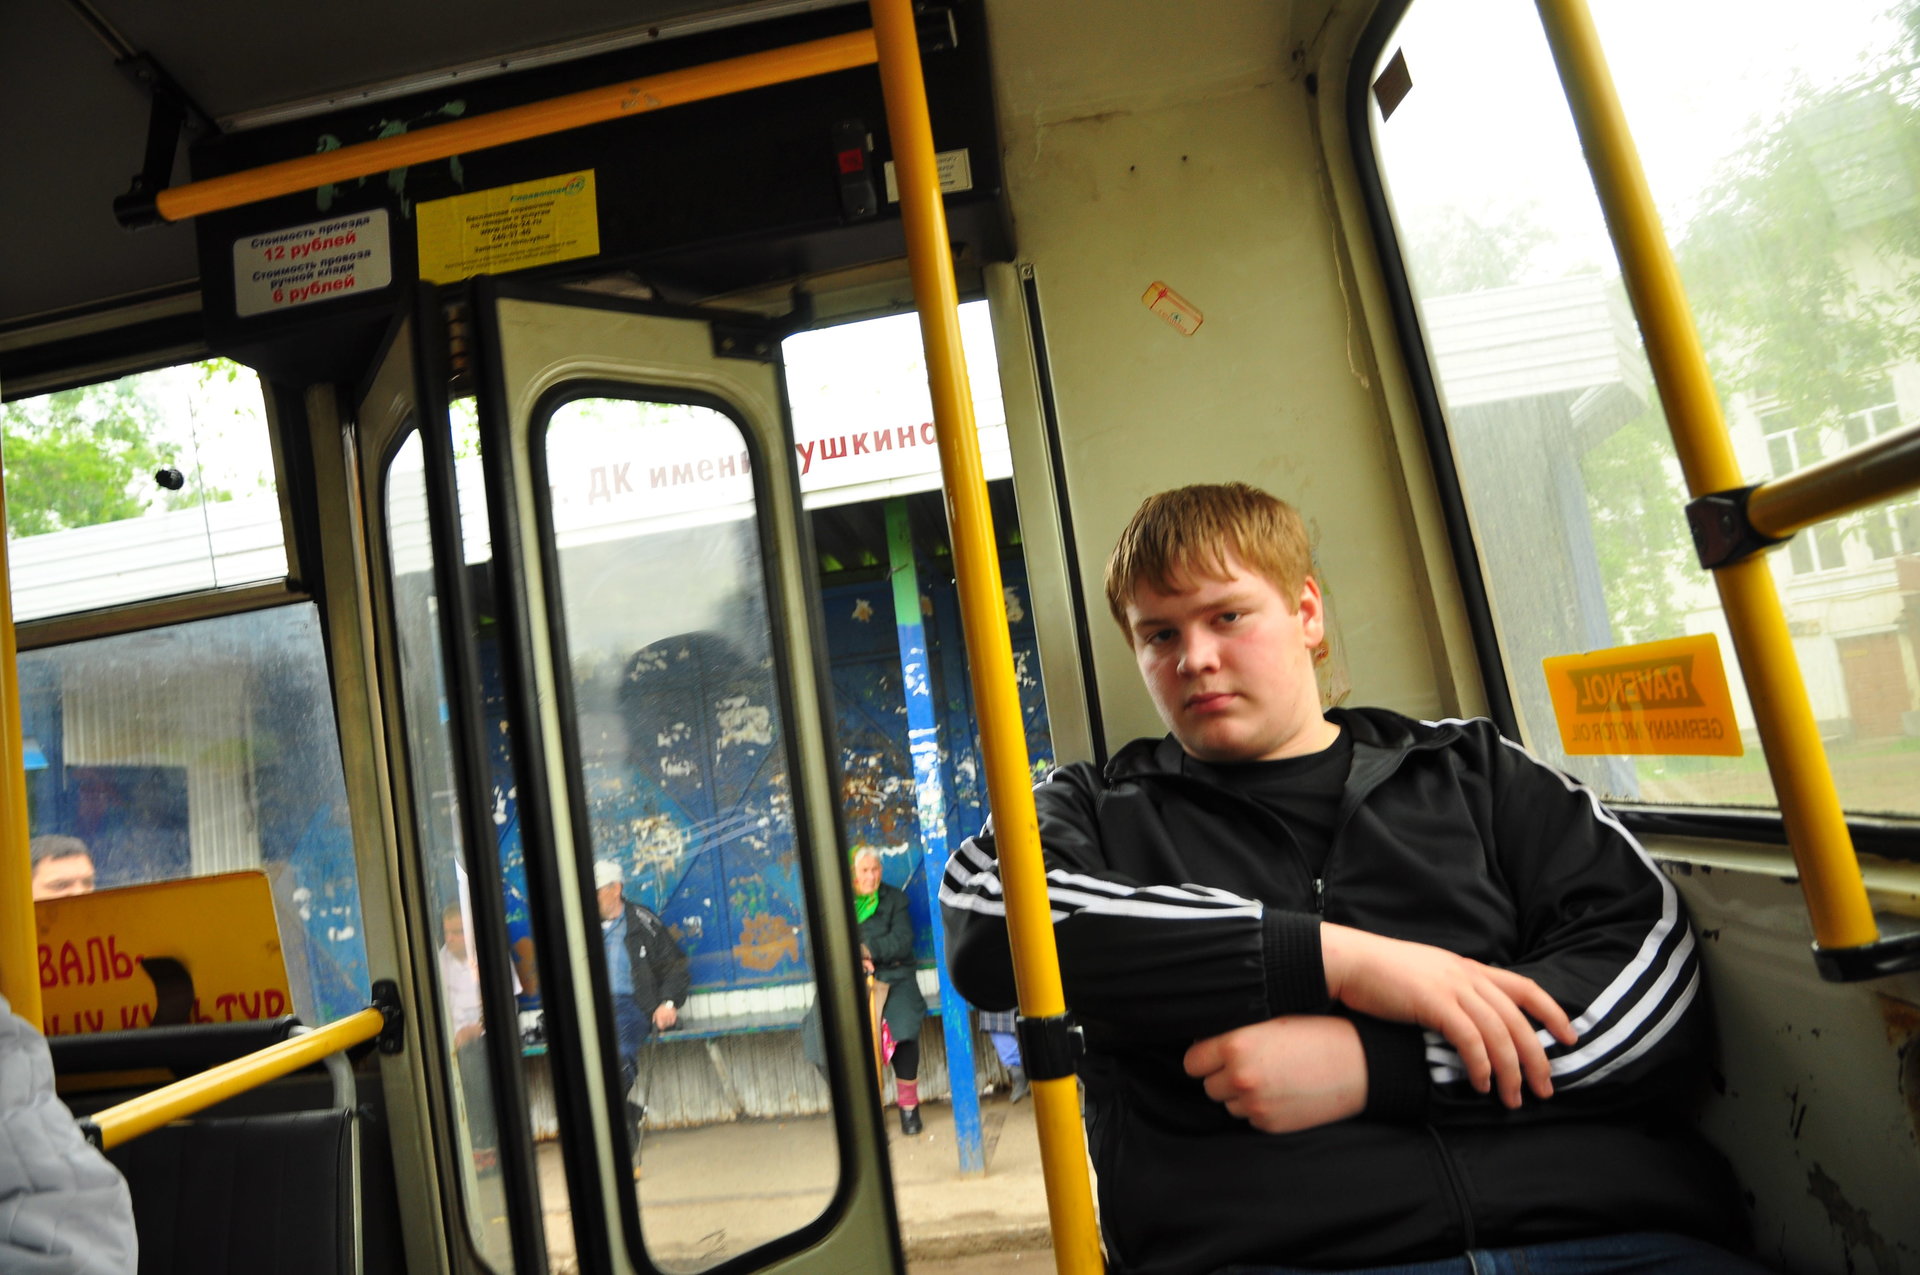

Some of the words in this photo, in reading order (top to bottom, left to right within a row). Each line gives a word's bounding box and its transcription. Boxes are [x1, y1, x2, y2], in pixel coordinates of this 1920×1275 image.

[251, 229, 315, 249] Стоимость
[319, 216, 370, 234] проезда
[264, 245, 285, 262] 12
[290, 229, 357, 260] рублей
[252, 261, 317, 281] Стоимость
[320, 249, 371, 267] провоза
[270, 270, 314, 290] ручной
[318, 262, 355, 279] клади
[273, 288, 284, 303] 6
[290, 273, 355, 303] рублей
[588, 461, 634, 506] ДК
